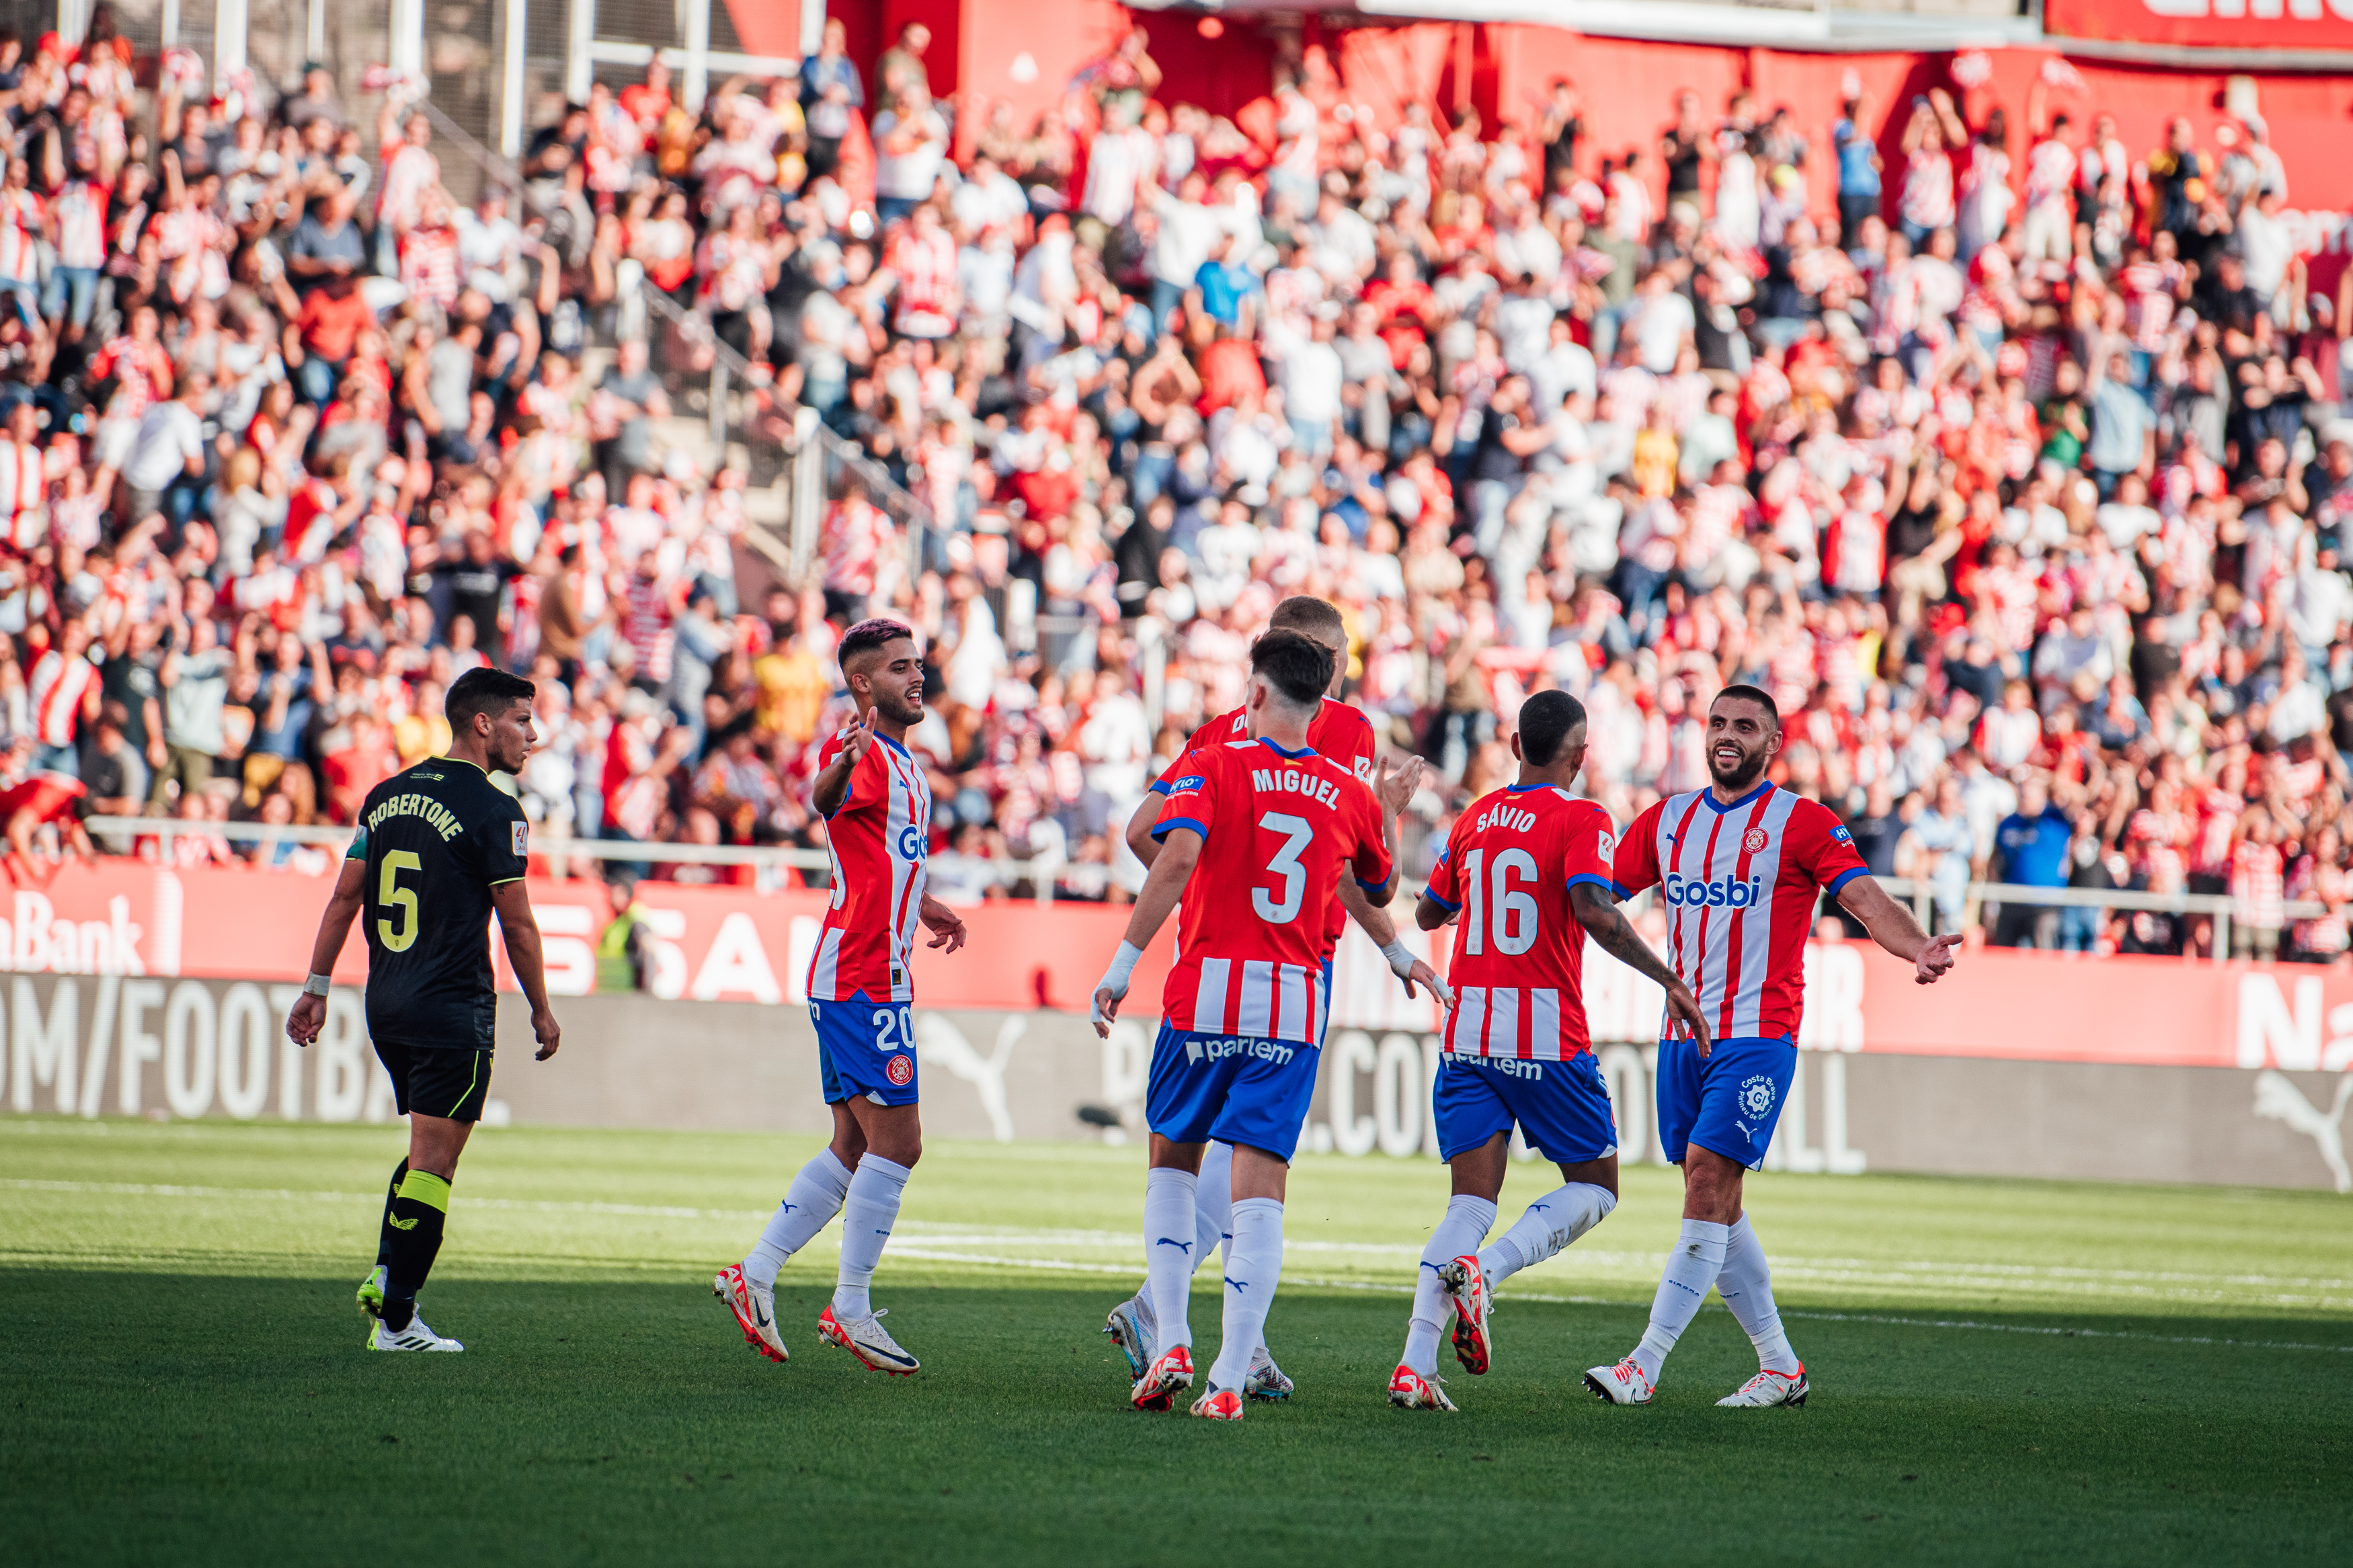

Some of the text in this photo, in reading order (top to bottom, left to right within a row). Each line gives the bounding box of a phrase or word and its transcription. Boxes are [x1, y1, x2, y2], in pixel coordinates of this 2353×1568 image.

[1252, 768, 1341, 811] MIGUEL
[368, 794, 463, 842] ROBERTONE
[1476, 802, 1536, 833] SÁVIO
[1251, 811, 1314, 924] 3
[377, 849, 423, 952] 5
[1464, 848, 1539, 956] 16
[1667, 874, 1761, 907] Gosbi
[873, 1006, 916, 1052] 20
[891, 1057, 908, 1065] GIRONA
[1205, 1037, 1294, 1065] parlem
[1741, 1074, 1776, 1101] Costa Brava
[1738, 1090, 1750, 1116] Pirineu
[1758, 1104, 1773, 1120] Girona
[1668, 1279, 1700, 1297] GIRONA
